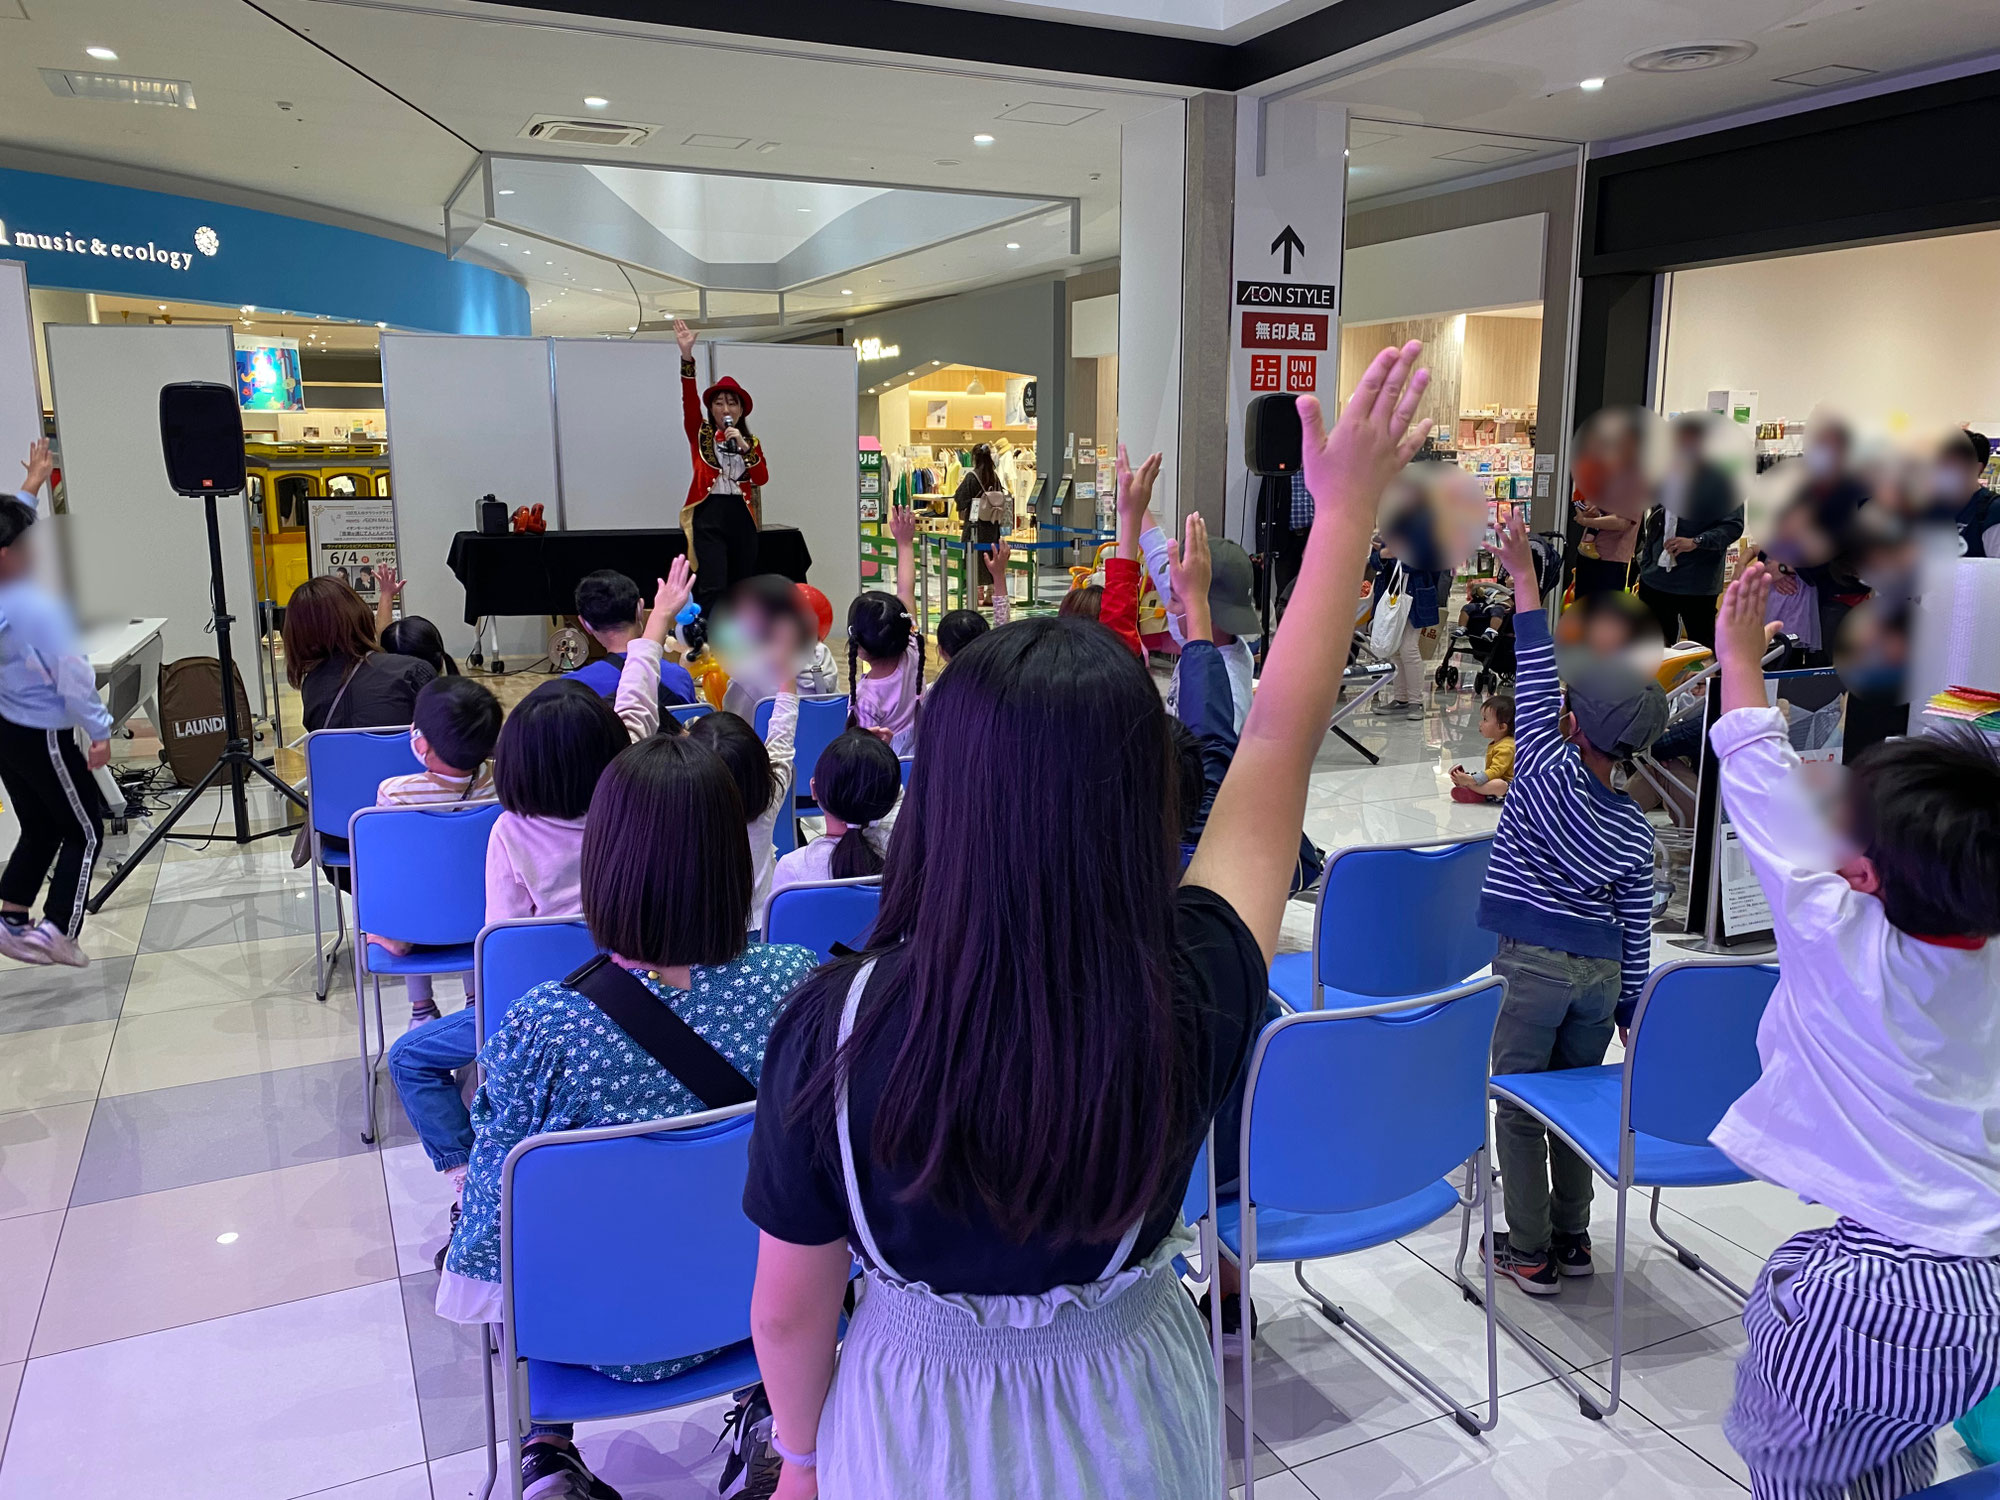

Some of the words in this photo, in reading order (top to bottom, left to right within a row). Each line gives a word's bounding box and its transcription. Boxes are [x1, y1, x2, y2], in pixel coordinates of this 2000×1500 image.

[1286, 287, 1330, 305] STYLE
[1255, 321, 1316, 341] 無印良品
[1255, 359, 1277, 372] ユニ
[1291, 360, 1311, 373] UNI
[1254, 374, 1277, 387] クロ
[1290, 375, 1313, 389] QLO
[330, 551, 358, 565] 6/4
[174, 714, 240, 738] LAUND
